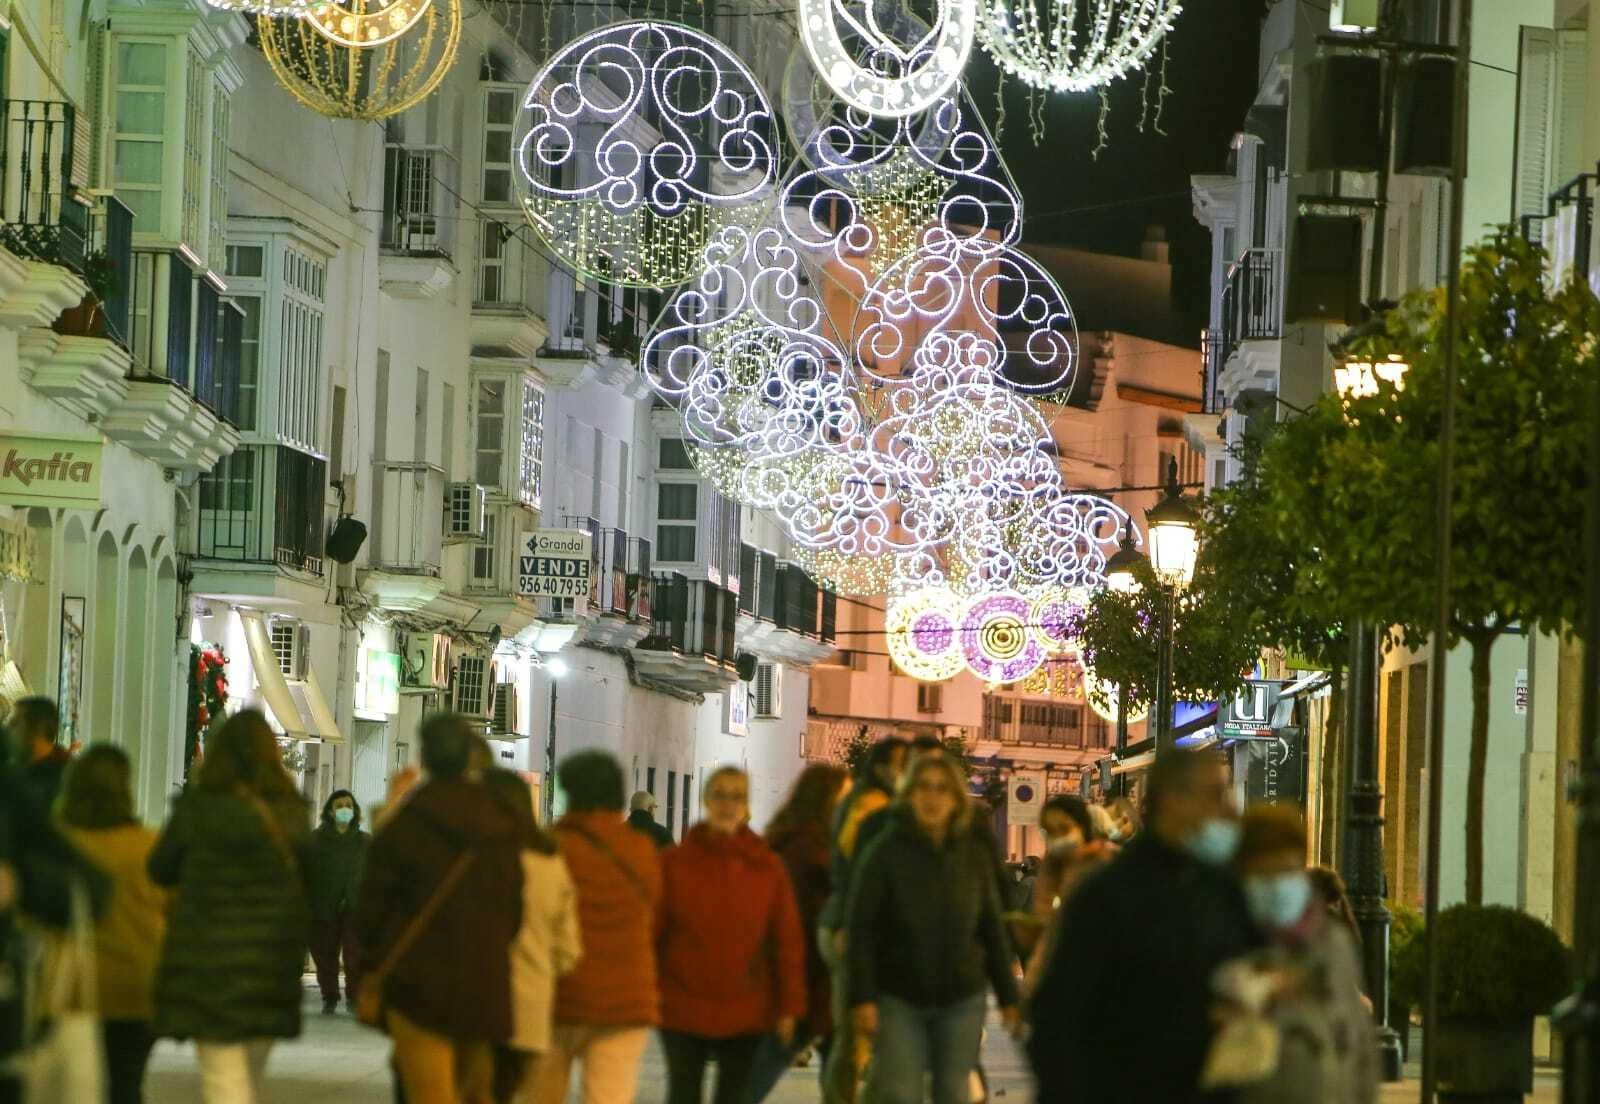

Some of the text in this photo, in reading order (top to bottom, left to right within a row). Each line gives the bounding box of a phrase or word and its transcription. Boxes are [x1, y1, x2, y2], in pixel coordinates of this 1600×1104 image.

[3, 448, 93, 487] katia
[540, 537, 583, 551] Grandal
[523, 558, 587, 576] VENDE
[520, 576, 588, 596] 956 40 79 55
